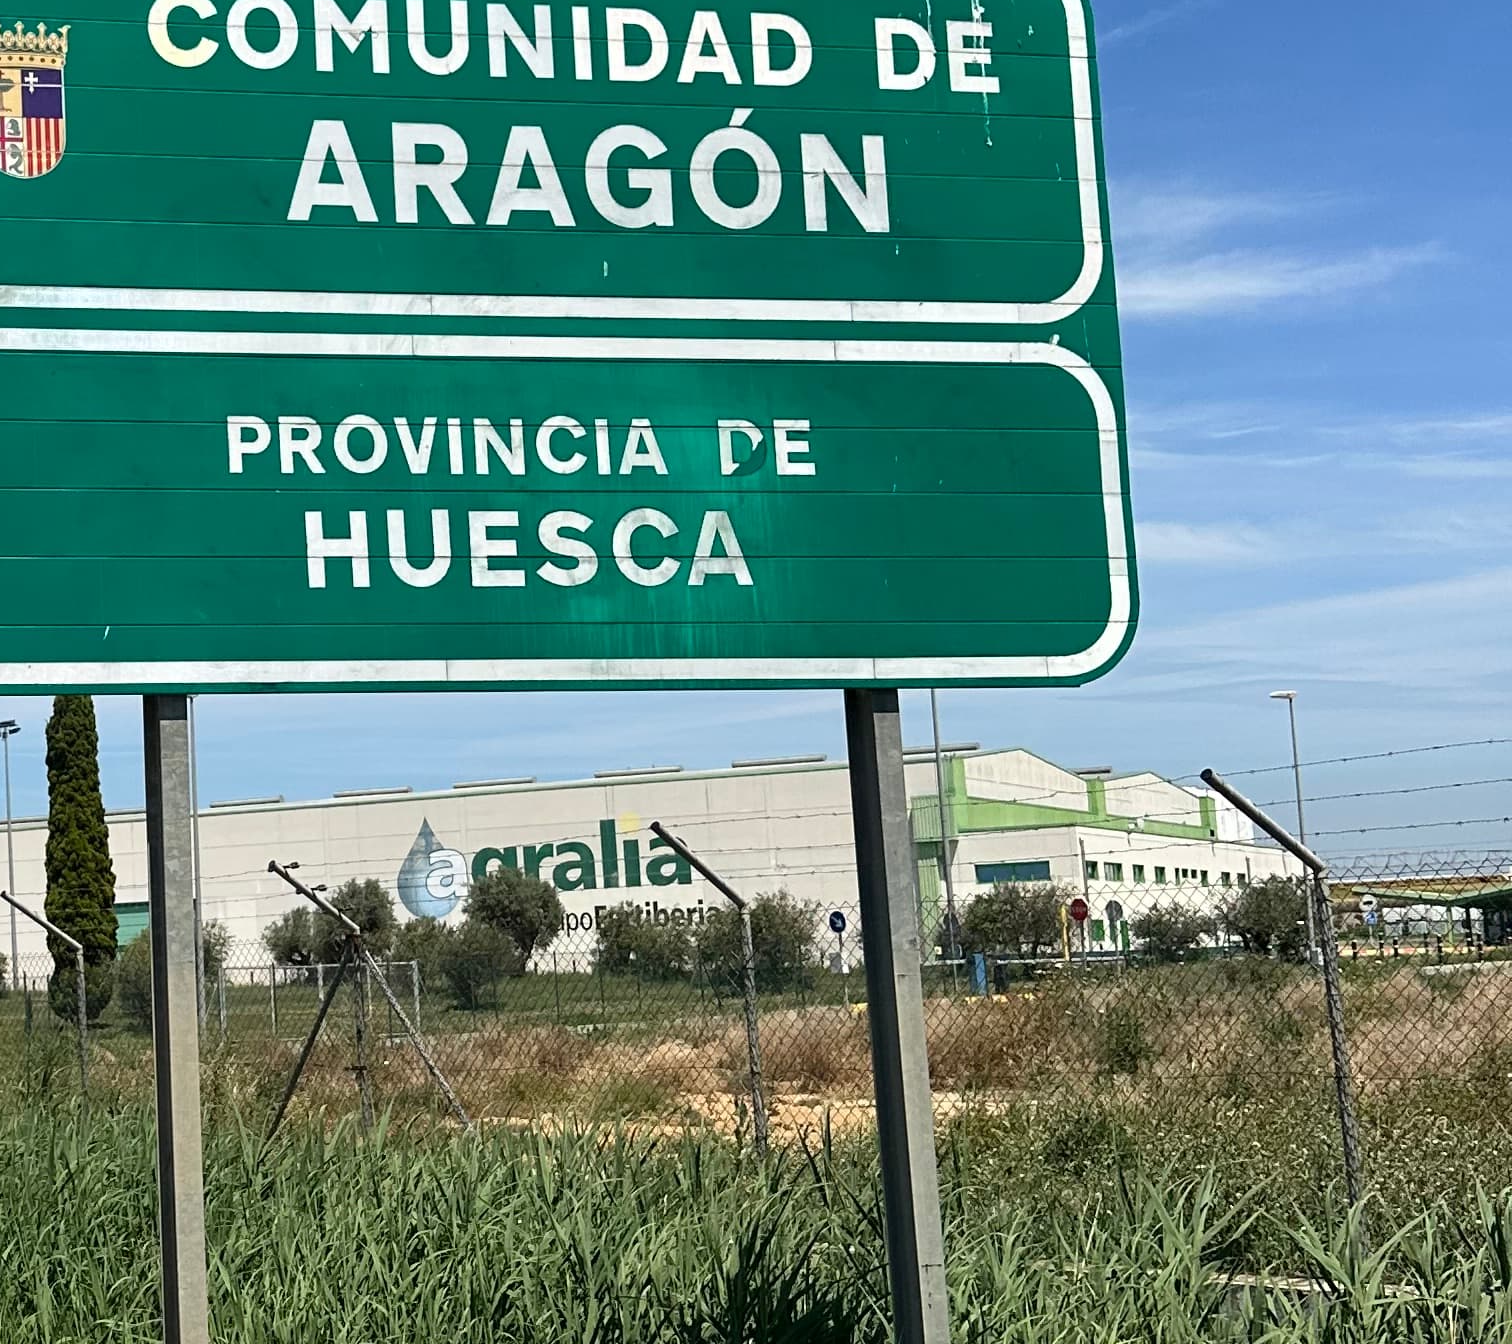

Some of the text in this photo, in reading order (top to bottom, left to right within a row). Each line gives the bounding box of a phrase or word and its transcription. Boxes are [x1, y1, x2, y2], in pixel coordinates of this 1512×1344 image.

[874, 17, 1000, 96] DE
[287, 107, 890, 233] ARAGÓN
[226, 414, 816, 476] PROVINCIA DE
[304, 509, 755, 589] HUESCA
